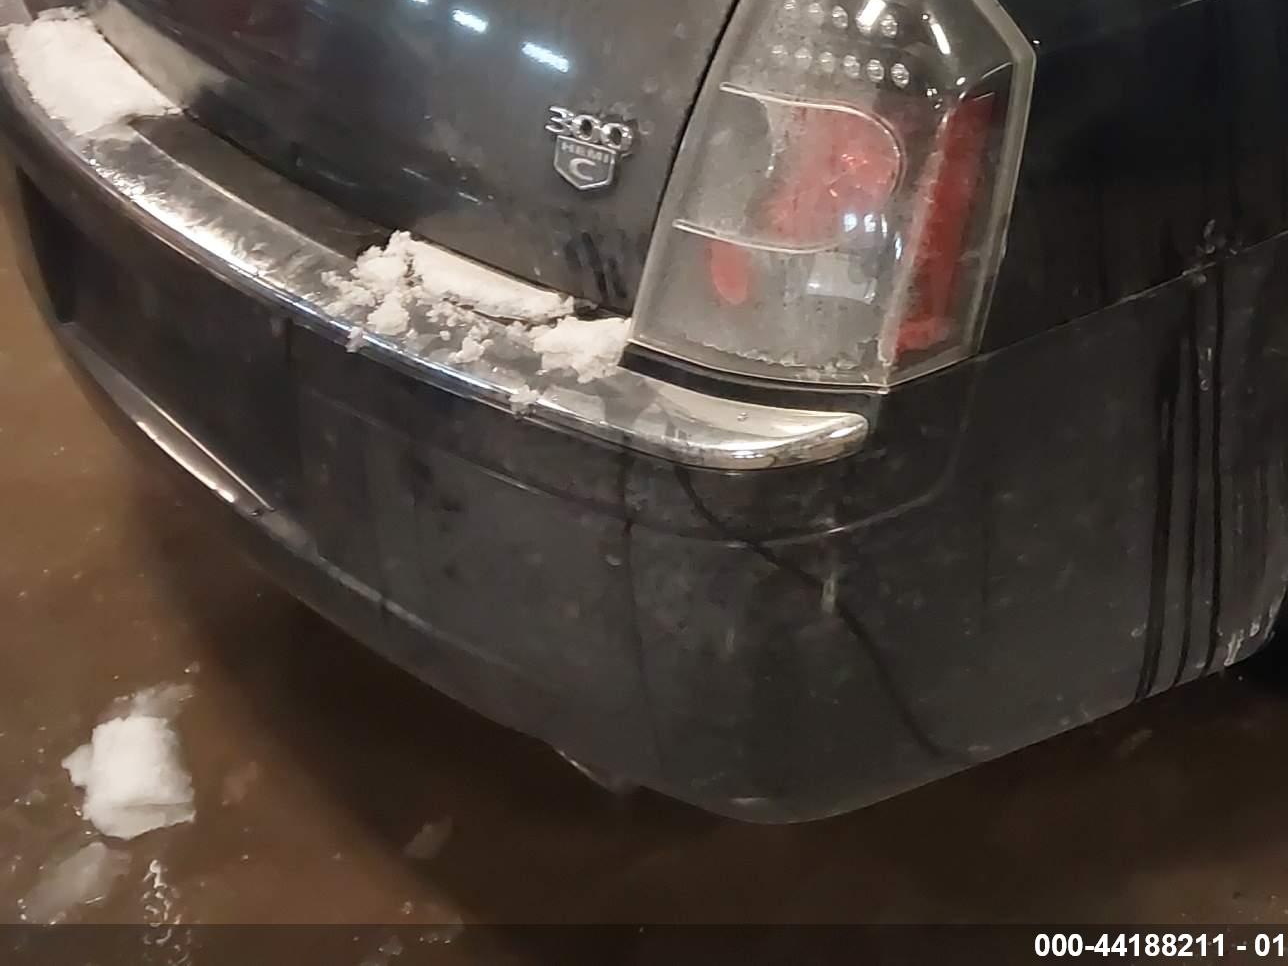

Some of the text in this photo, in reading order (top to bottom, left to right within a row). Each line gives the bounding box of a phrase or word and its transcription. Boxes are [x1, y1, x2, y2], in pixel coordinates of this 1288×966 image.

[544, 106, 634, 156] 300
[560, 141, 610, 163] HEMI
[568, 158, 598, 182] C
